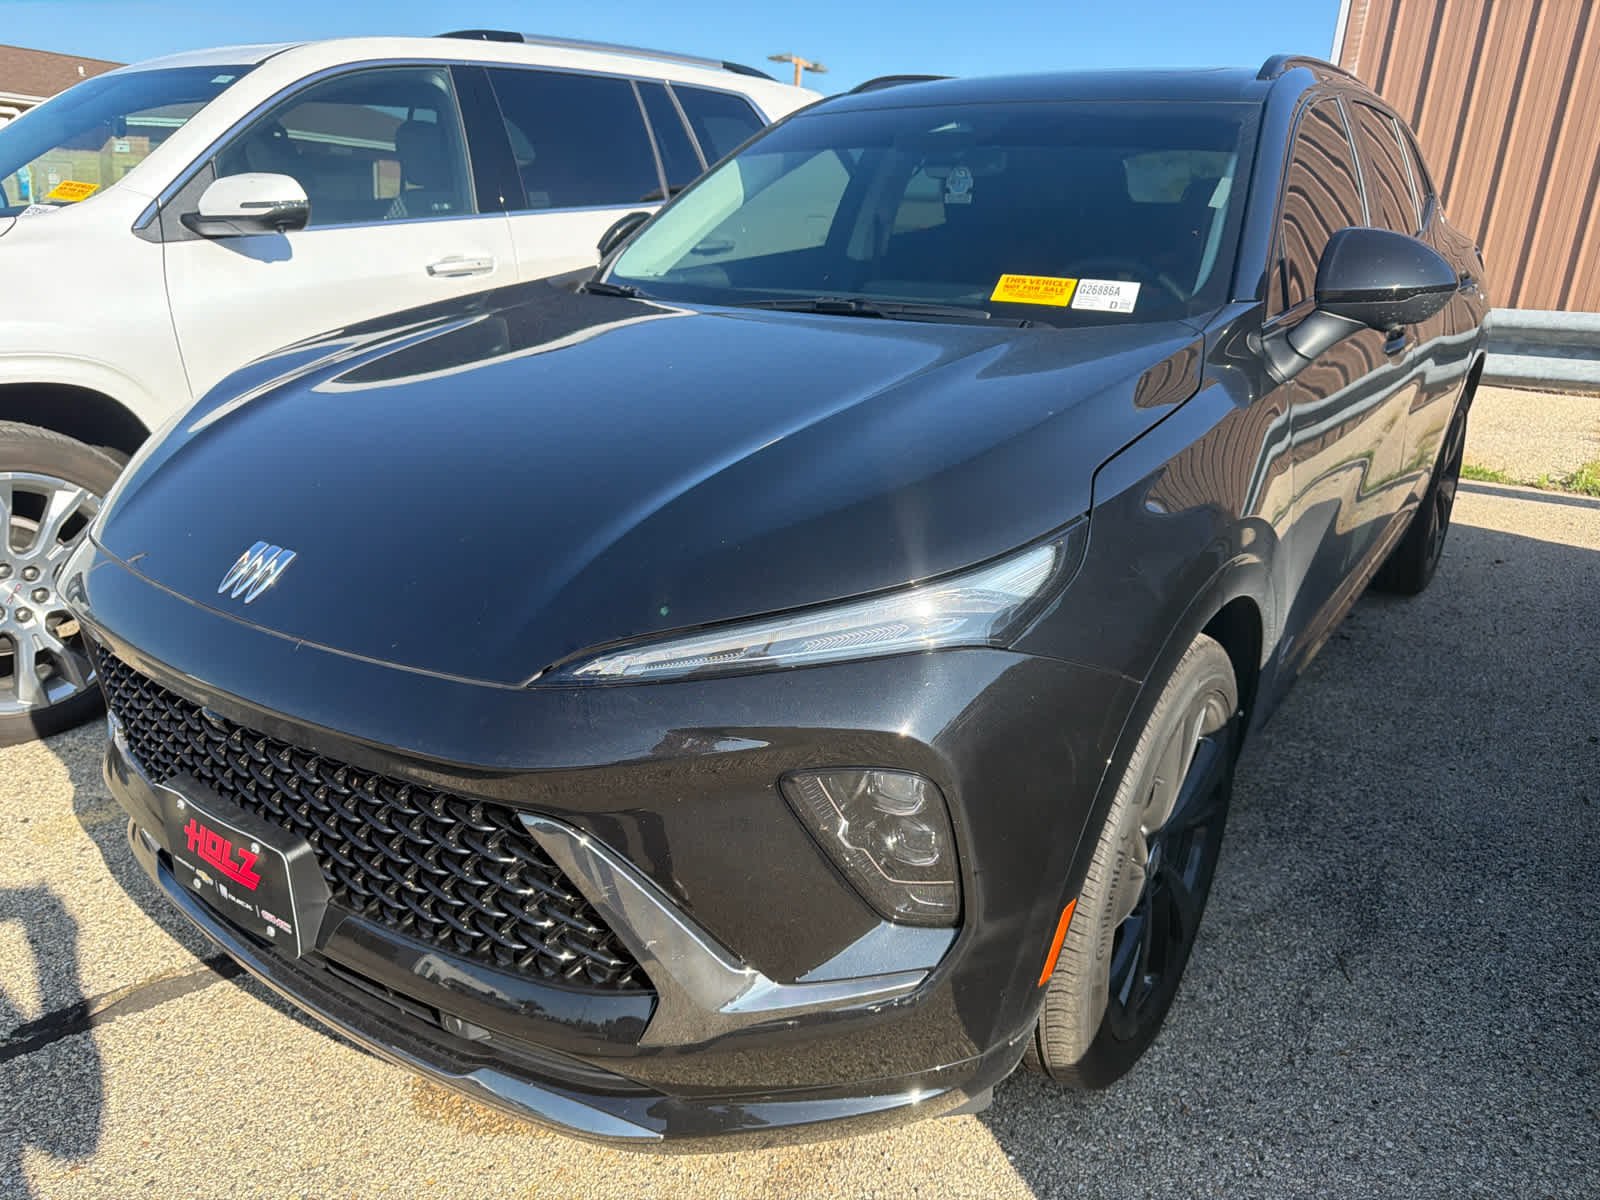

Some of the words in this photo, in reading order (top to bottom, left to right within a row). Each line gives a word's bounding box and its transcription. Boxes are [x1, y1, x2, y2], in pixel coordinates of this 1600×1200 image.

[1029, 279, 1071, 288] VEHICLE
[1080, 284, 1121, 297] G26886A
[184, 817, 261, 891] HOLZ
[1096, 850, 1125, 960] Continental
